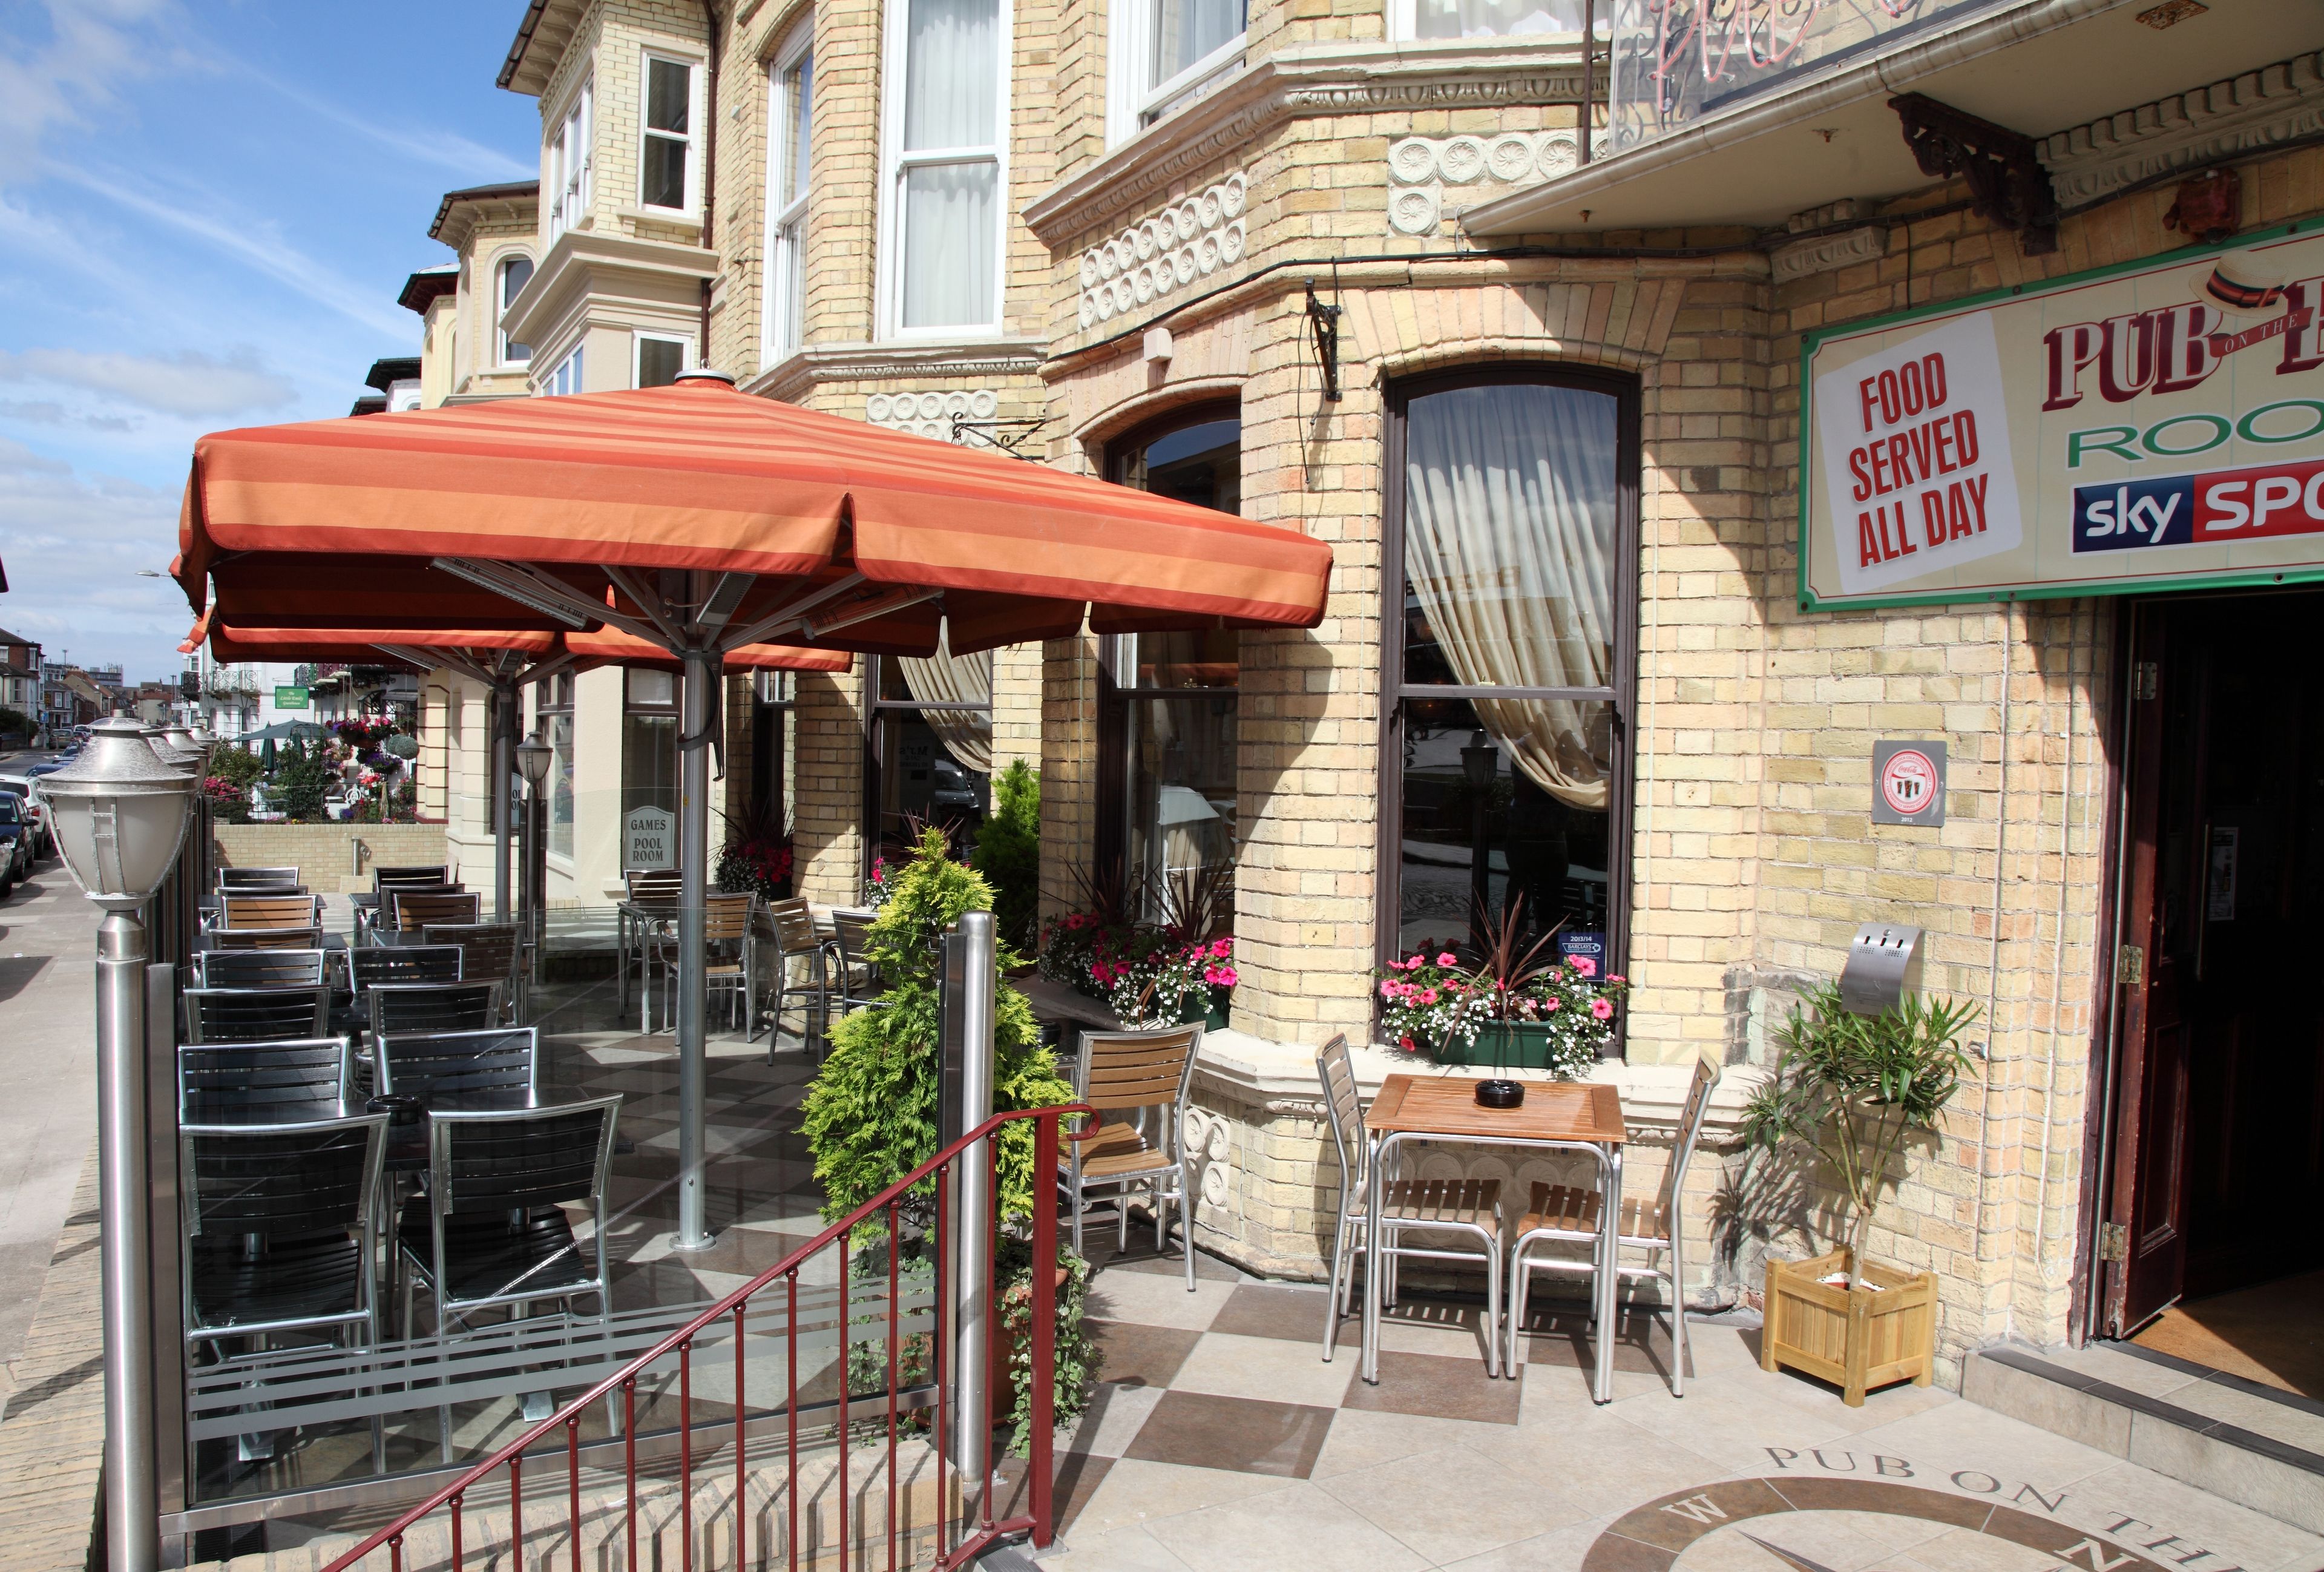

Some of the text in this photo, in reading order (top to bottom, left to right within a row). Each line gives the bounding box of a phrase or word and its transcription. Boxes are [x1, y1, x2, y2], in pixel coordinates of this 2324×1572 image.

[2042, 303, 2222, 412] PUB
[2225, 314, 2298, 353] ON THE
[1859, 352, 1947, 433] FOOD
[1849, 409, 1979, 502] SERVED
[1858, 473, 1988, 568] ALL DAY
[2086, 486, 2181, 543] sky
[631, 820, 666, 830] GAMES
[634, 838, 662, 849] POOL
[632, 850, 663, 861] ROOM
[1659, 1493, 1728, 1525] W
[1762, 1447, 2248, 1572] PUB ON TH
